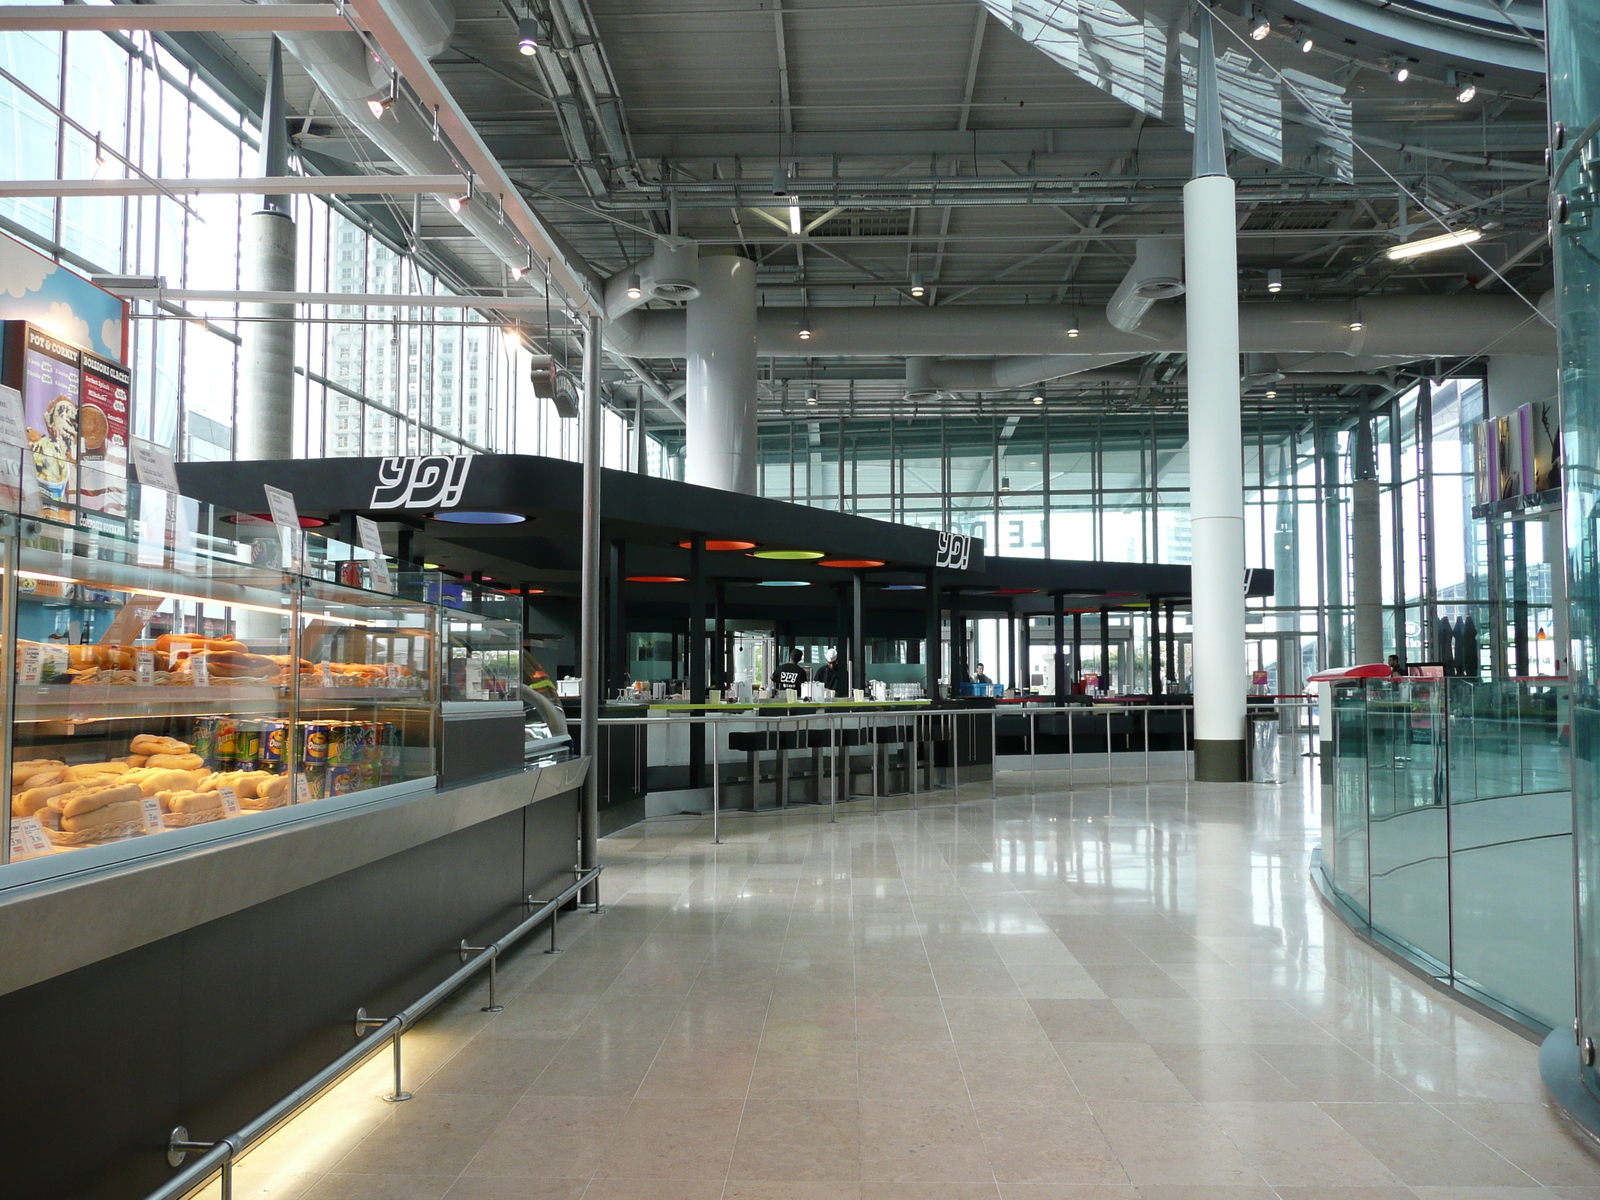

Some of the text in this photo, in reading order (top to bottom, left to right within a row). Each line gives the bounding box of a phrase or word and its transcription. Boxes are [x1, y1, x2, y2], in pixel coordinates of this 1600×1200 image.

[30, 333, 77, 361] POT & CORNET
[83, 356, 110, 376] BOISSONS
